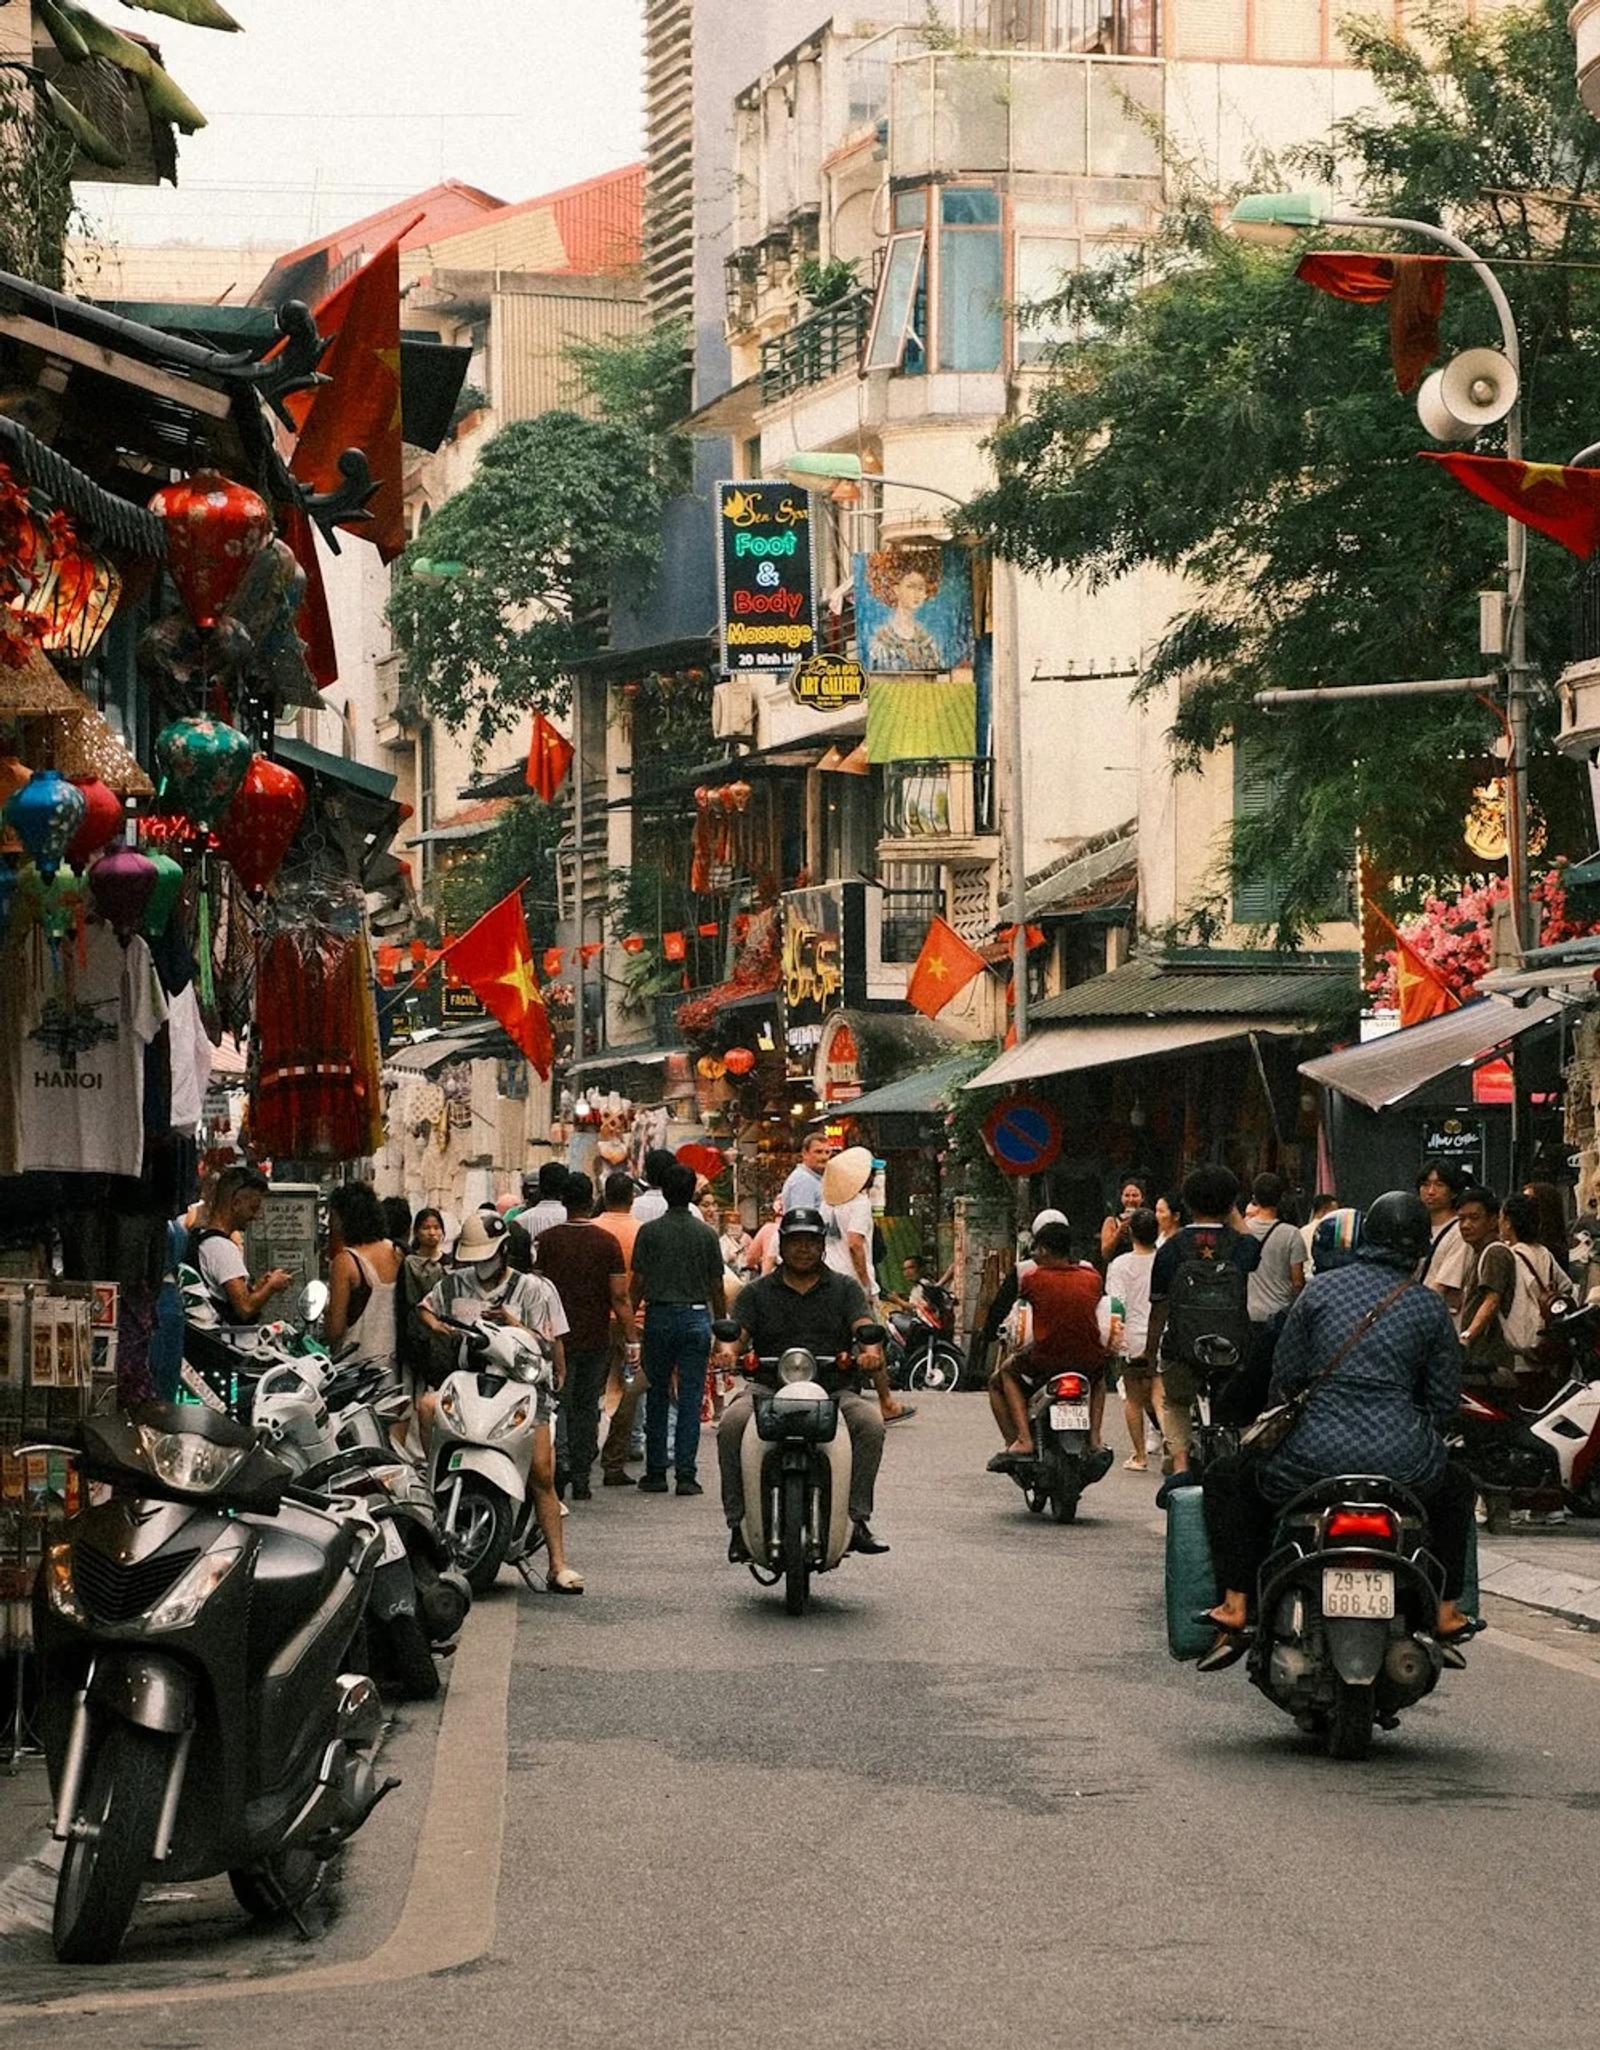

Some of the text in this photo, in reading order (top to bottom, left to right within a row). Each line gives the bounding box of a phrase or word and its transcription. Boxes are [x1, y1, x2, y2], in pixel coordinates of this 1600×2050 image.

[735, 530, 797, 557] Foot
[756, 561, 779, 586] &
[734, 587, 803, 618] Body
[727, 622, 813, 648] Massage
[738, 653, 754, 667] 20
[801, 675, 861, 695] ART GALLERY
[34, 1071, 102, 1090] HANOI
[1334, 1572, 1383, 1592] 29-Y5
[1328, 1593, 1389, 1615] 686.48
